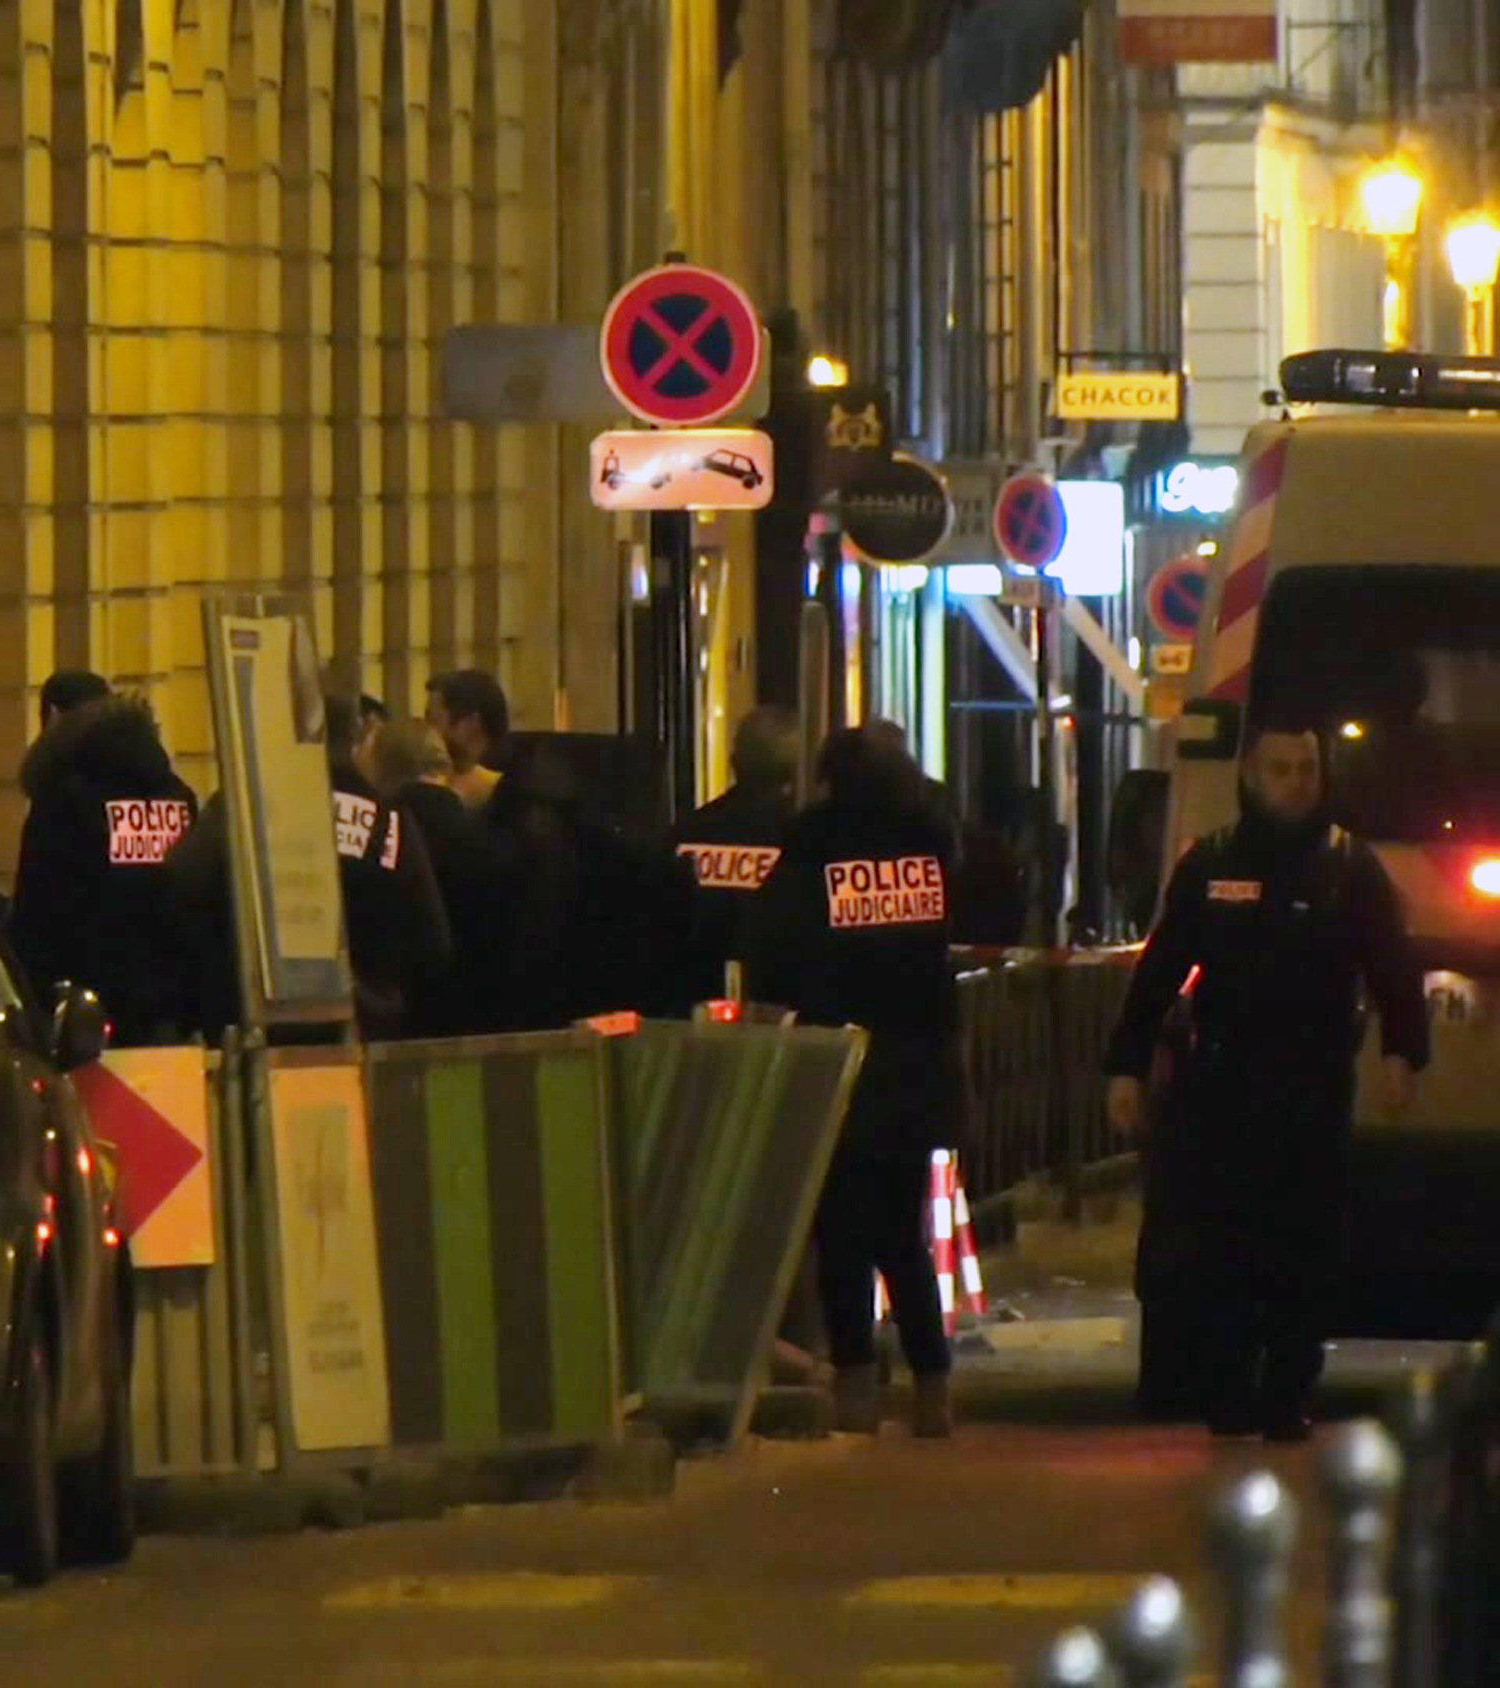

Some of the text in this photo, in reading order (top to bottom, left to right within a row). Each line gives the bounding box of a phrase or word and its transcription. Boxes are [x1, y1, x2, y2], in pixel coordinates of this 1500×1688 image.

[1062, 386, 1172, 406] CHACOK
[109, 802, 190, 833] POLICE
[333, 800, 377, 829] LIC
[681, 849, 772, 883] OLICE
[828, 858, 939, 896] POLICE
[833, 890, 942, 924] JUDICIAIRE
